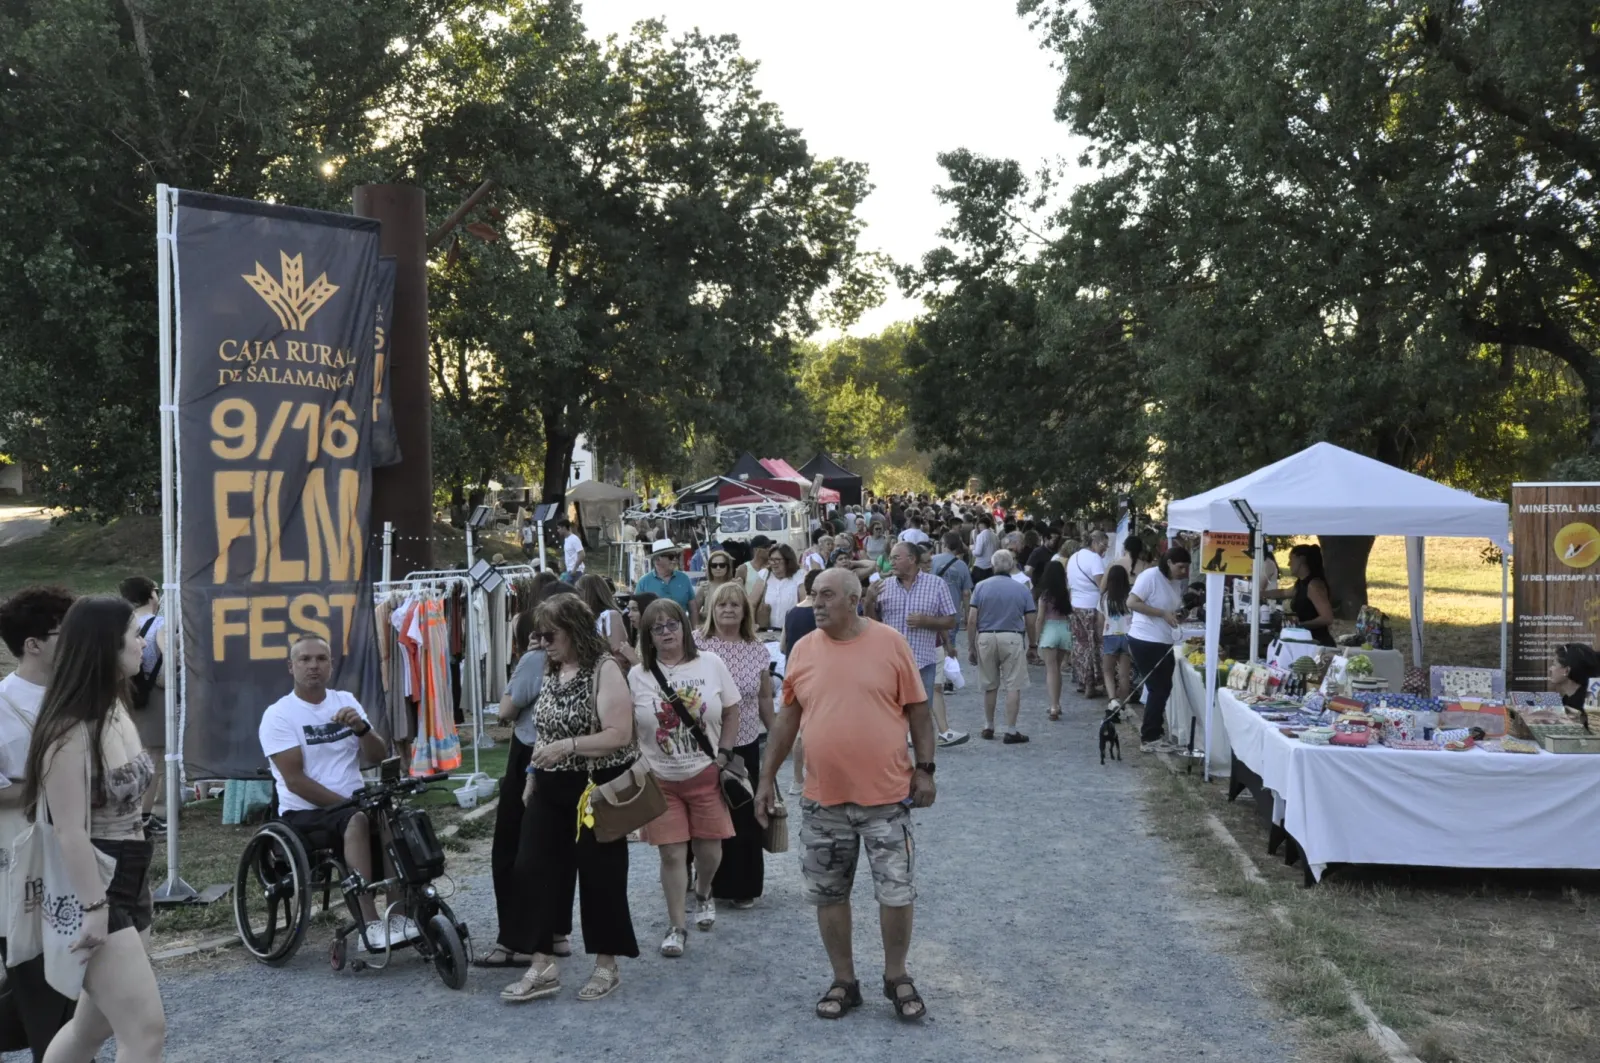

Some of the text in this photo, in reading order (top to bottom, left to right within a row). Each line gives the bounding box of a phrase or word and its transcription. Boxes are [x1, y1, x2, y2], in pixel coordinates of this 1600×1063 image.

[219, 339, 356, 369] CAJA RURAL
[218, 369, 242, 386] DE
[247, 366, 355, 392] SALAMANCA
[209, 398, 359, 462] 9/16
[1519, 504, 1576, 513] MINESTAL
[213, 467, 363, 585] FILM
[211, 593, 358, 662] FEST
[681, 679, 705, 688] BLOOM
